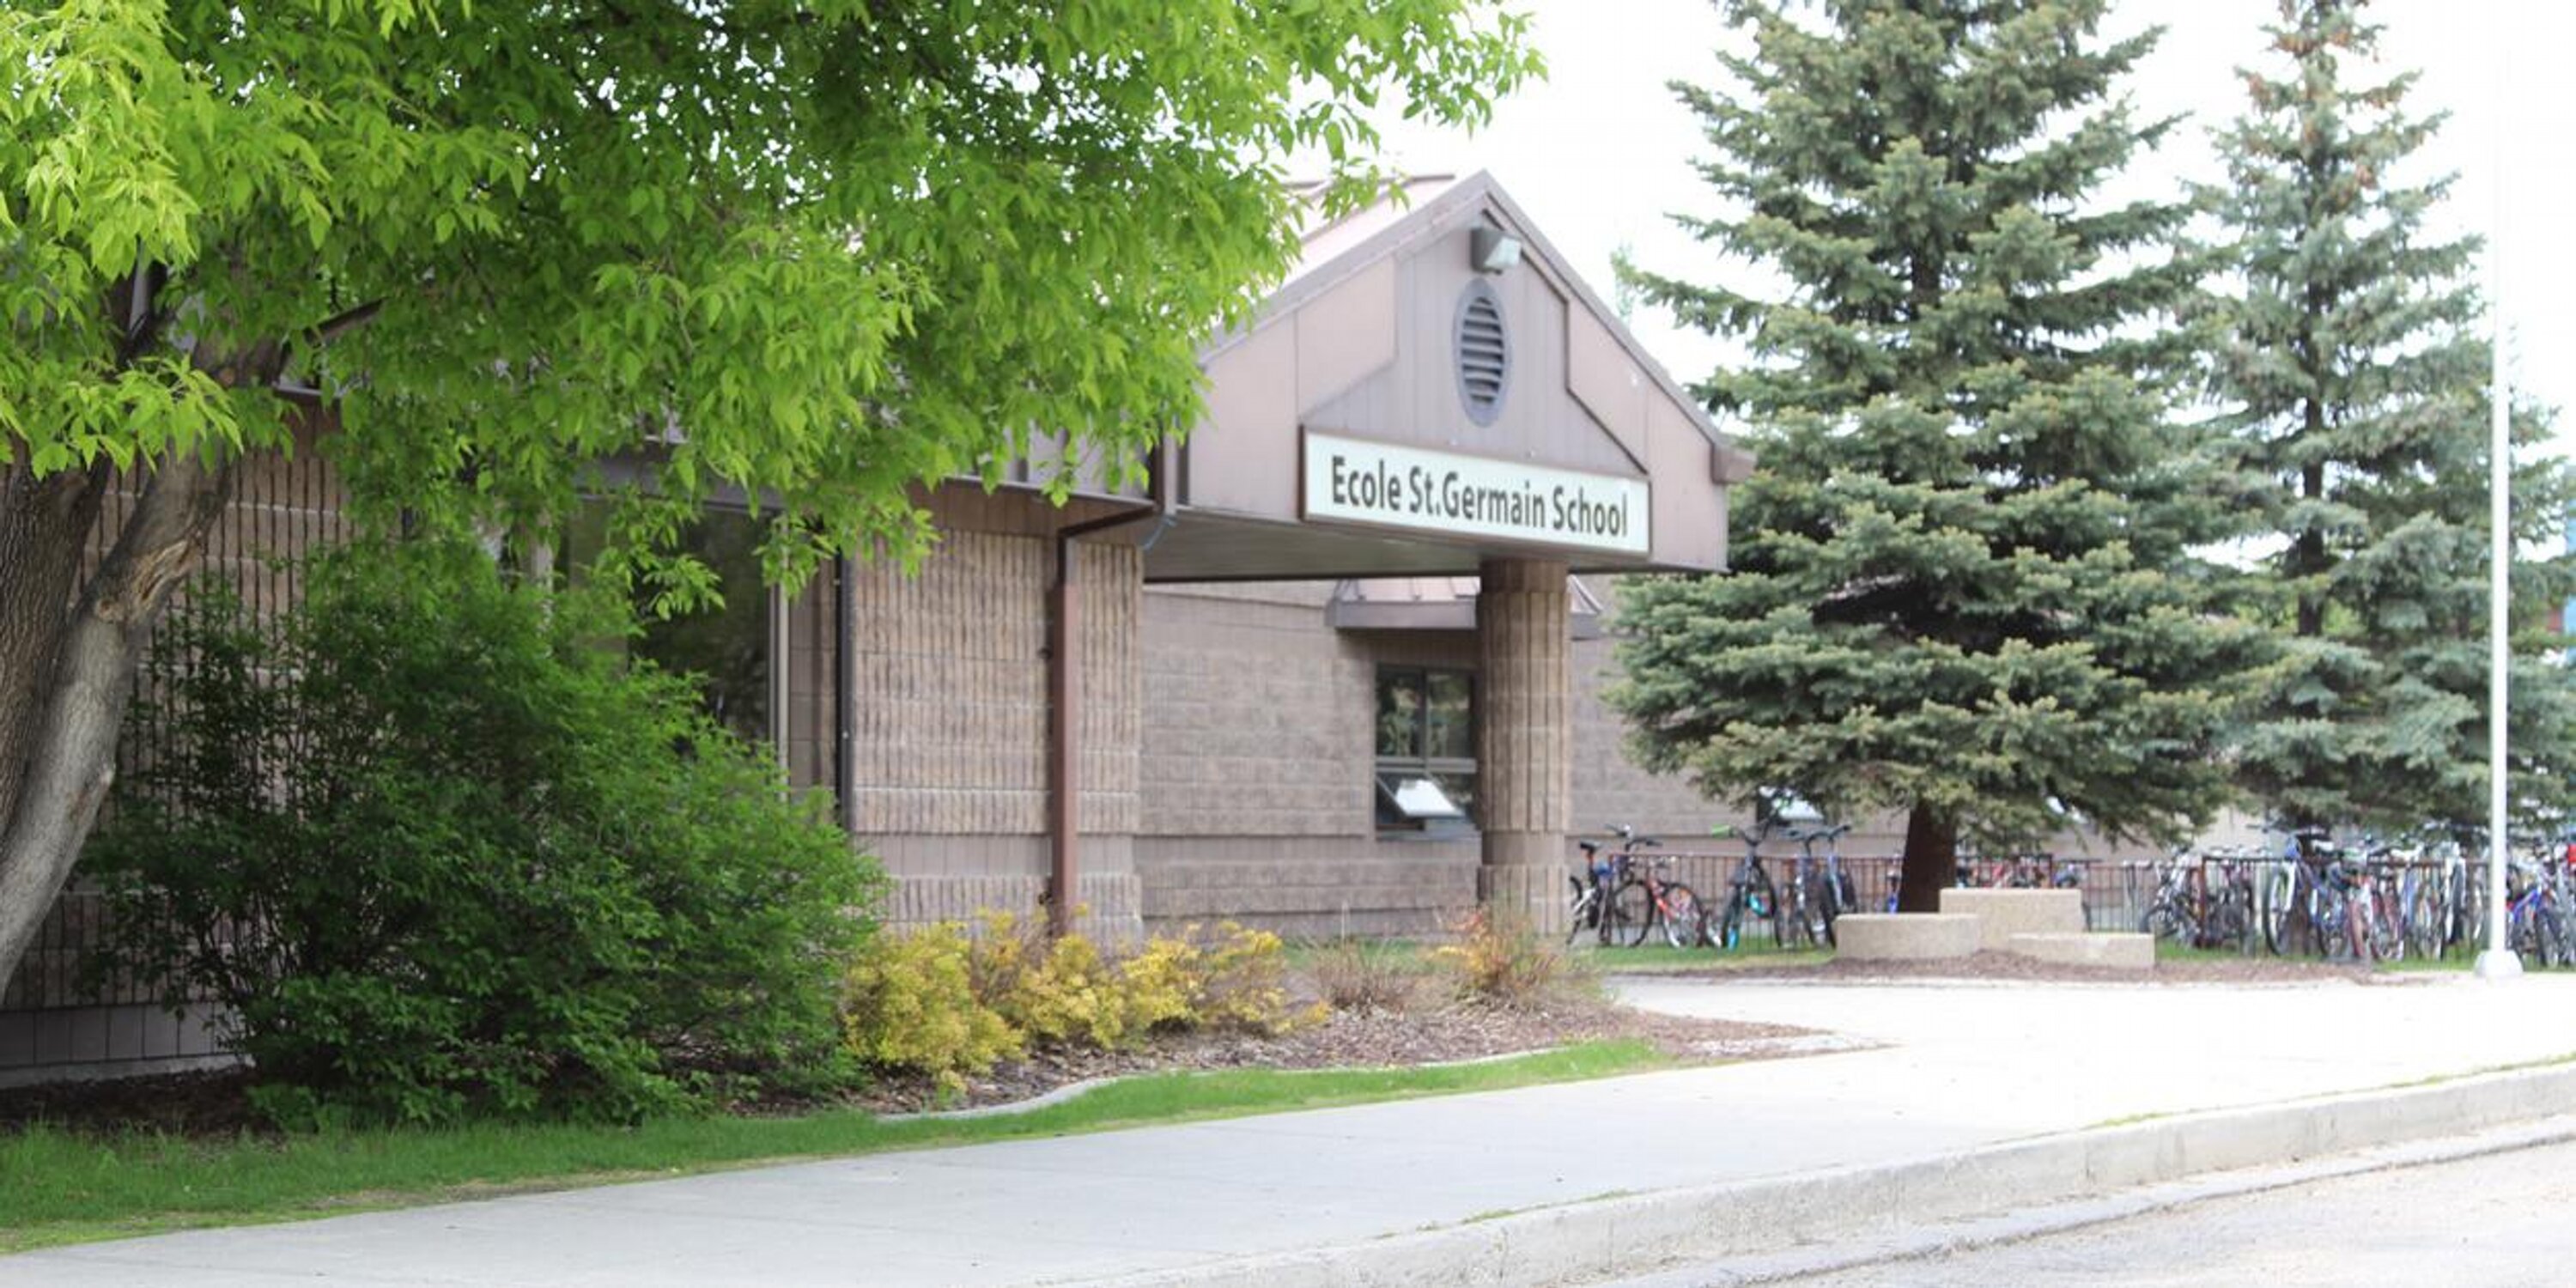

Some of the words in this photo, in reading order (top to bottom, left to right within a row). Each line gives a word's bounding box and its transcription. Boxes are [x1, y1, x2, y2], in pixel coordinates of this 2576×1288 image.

[1331, 455, 1401, 512] Ecole
[1409, 465, 1546, 528] St.Germain
[1552, 484, 1629, 538] School
